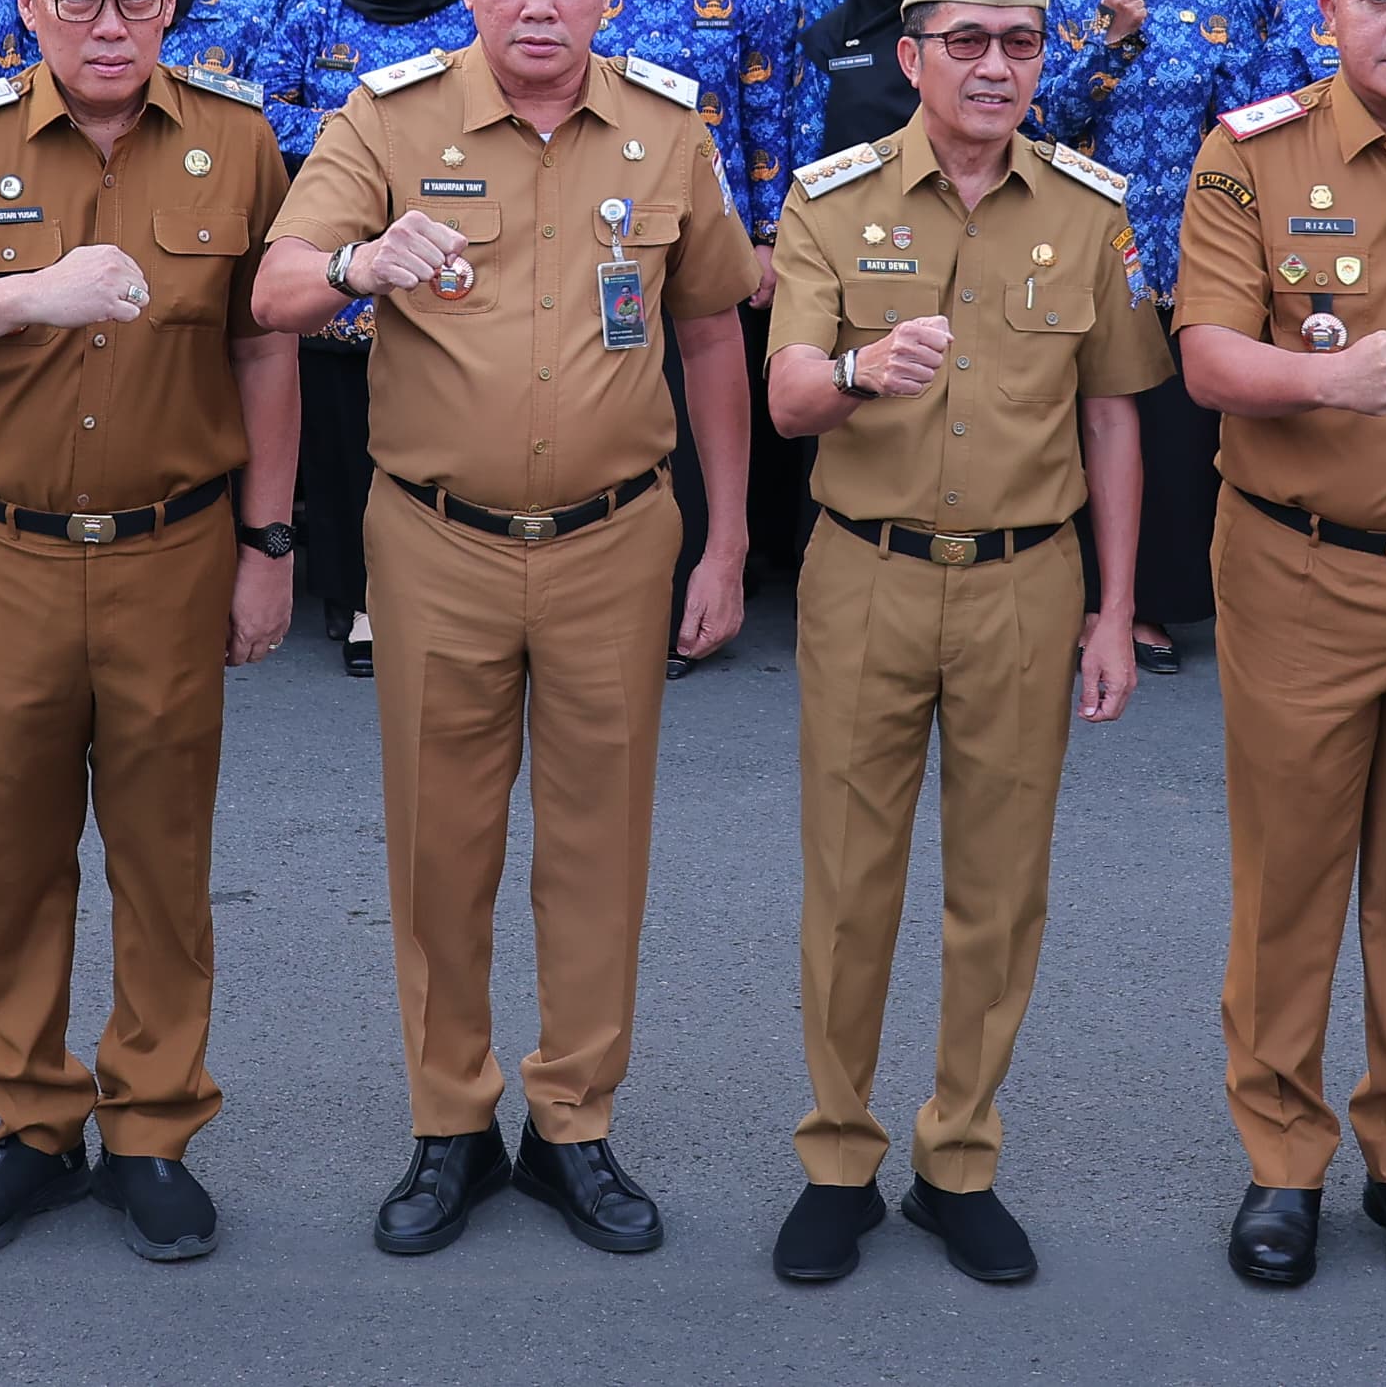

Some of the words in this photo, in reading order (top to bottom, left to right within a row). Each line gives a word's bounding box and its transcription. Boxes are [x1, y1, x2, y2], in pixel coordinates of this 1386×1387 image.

[1305, 221, 1339, 230] RIZAL
[867, 261, 886, 270] RATU
[888, 262, 910, 271] DEWA
